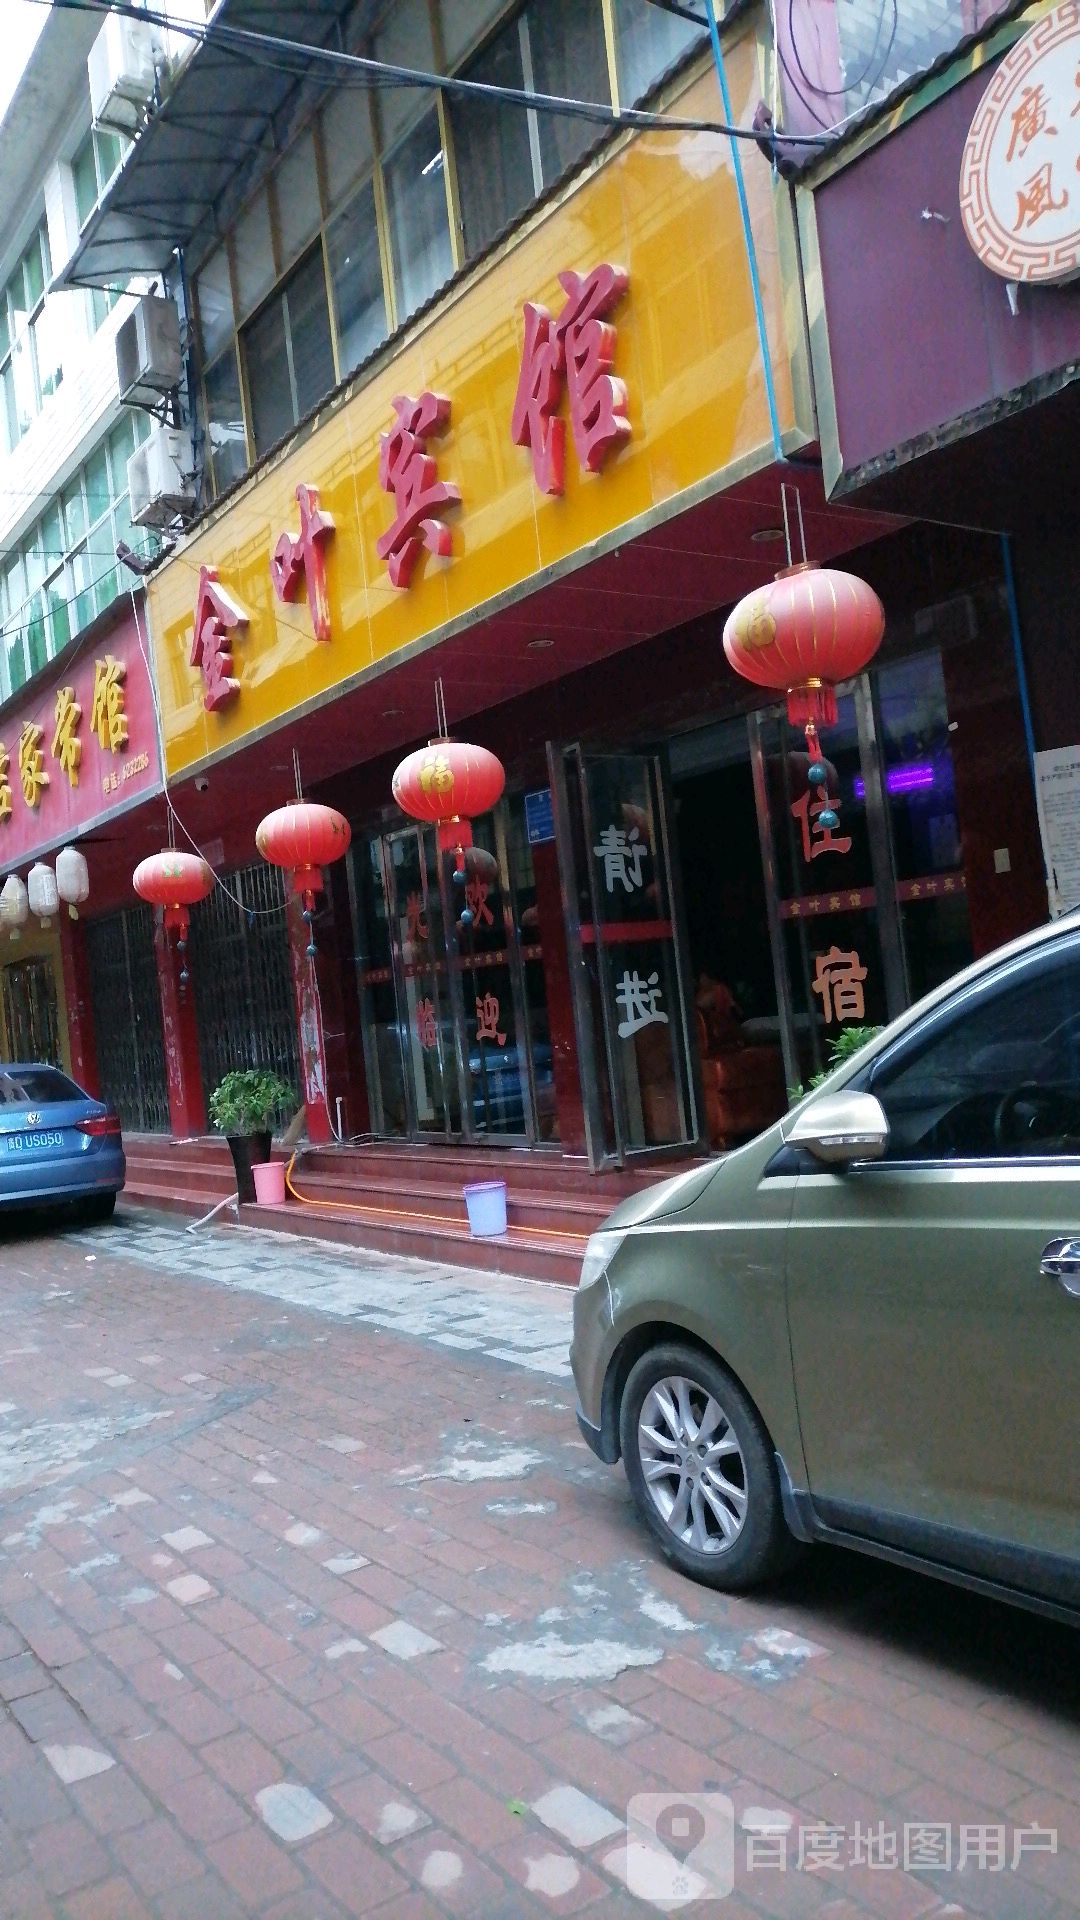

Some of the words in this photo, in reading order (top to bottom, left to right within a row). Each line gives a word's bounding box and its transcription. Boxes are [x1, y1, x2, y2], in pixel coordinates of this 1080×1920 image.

[190, 263, 632, 713] 金叶宾馆
[790, 892, 861, 915] 金叶宾馆
[791, 785, 867, 1024] 住宿
